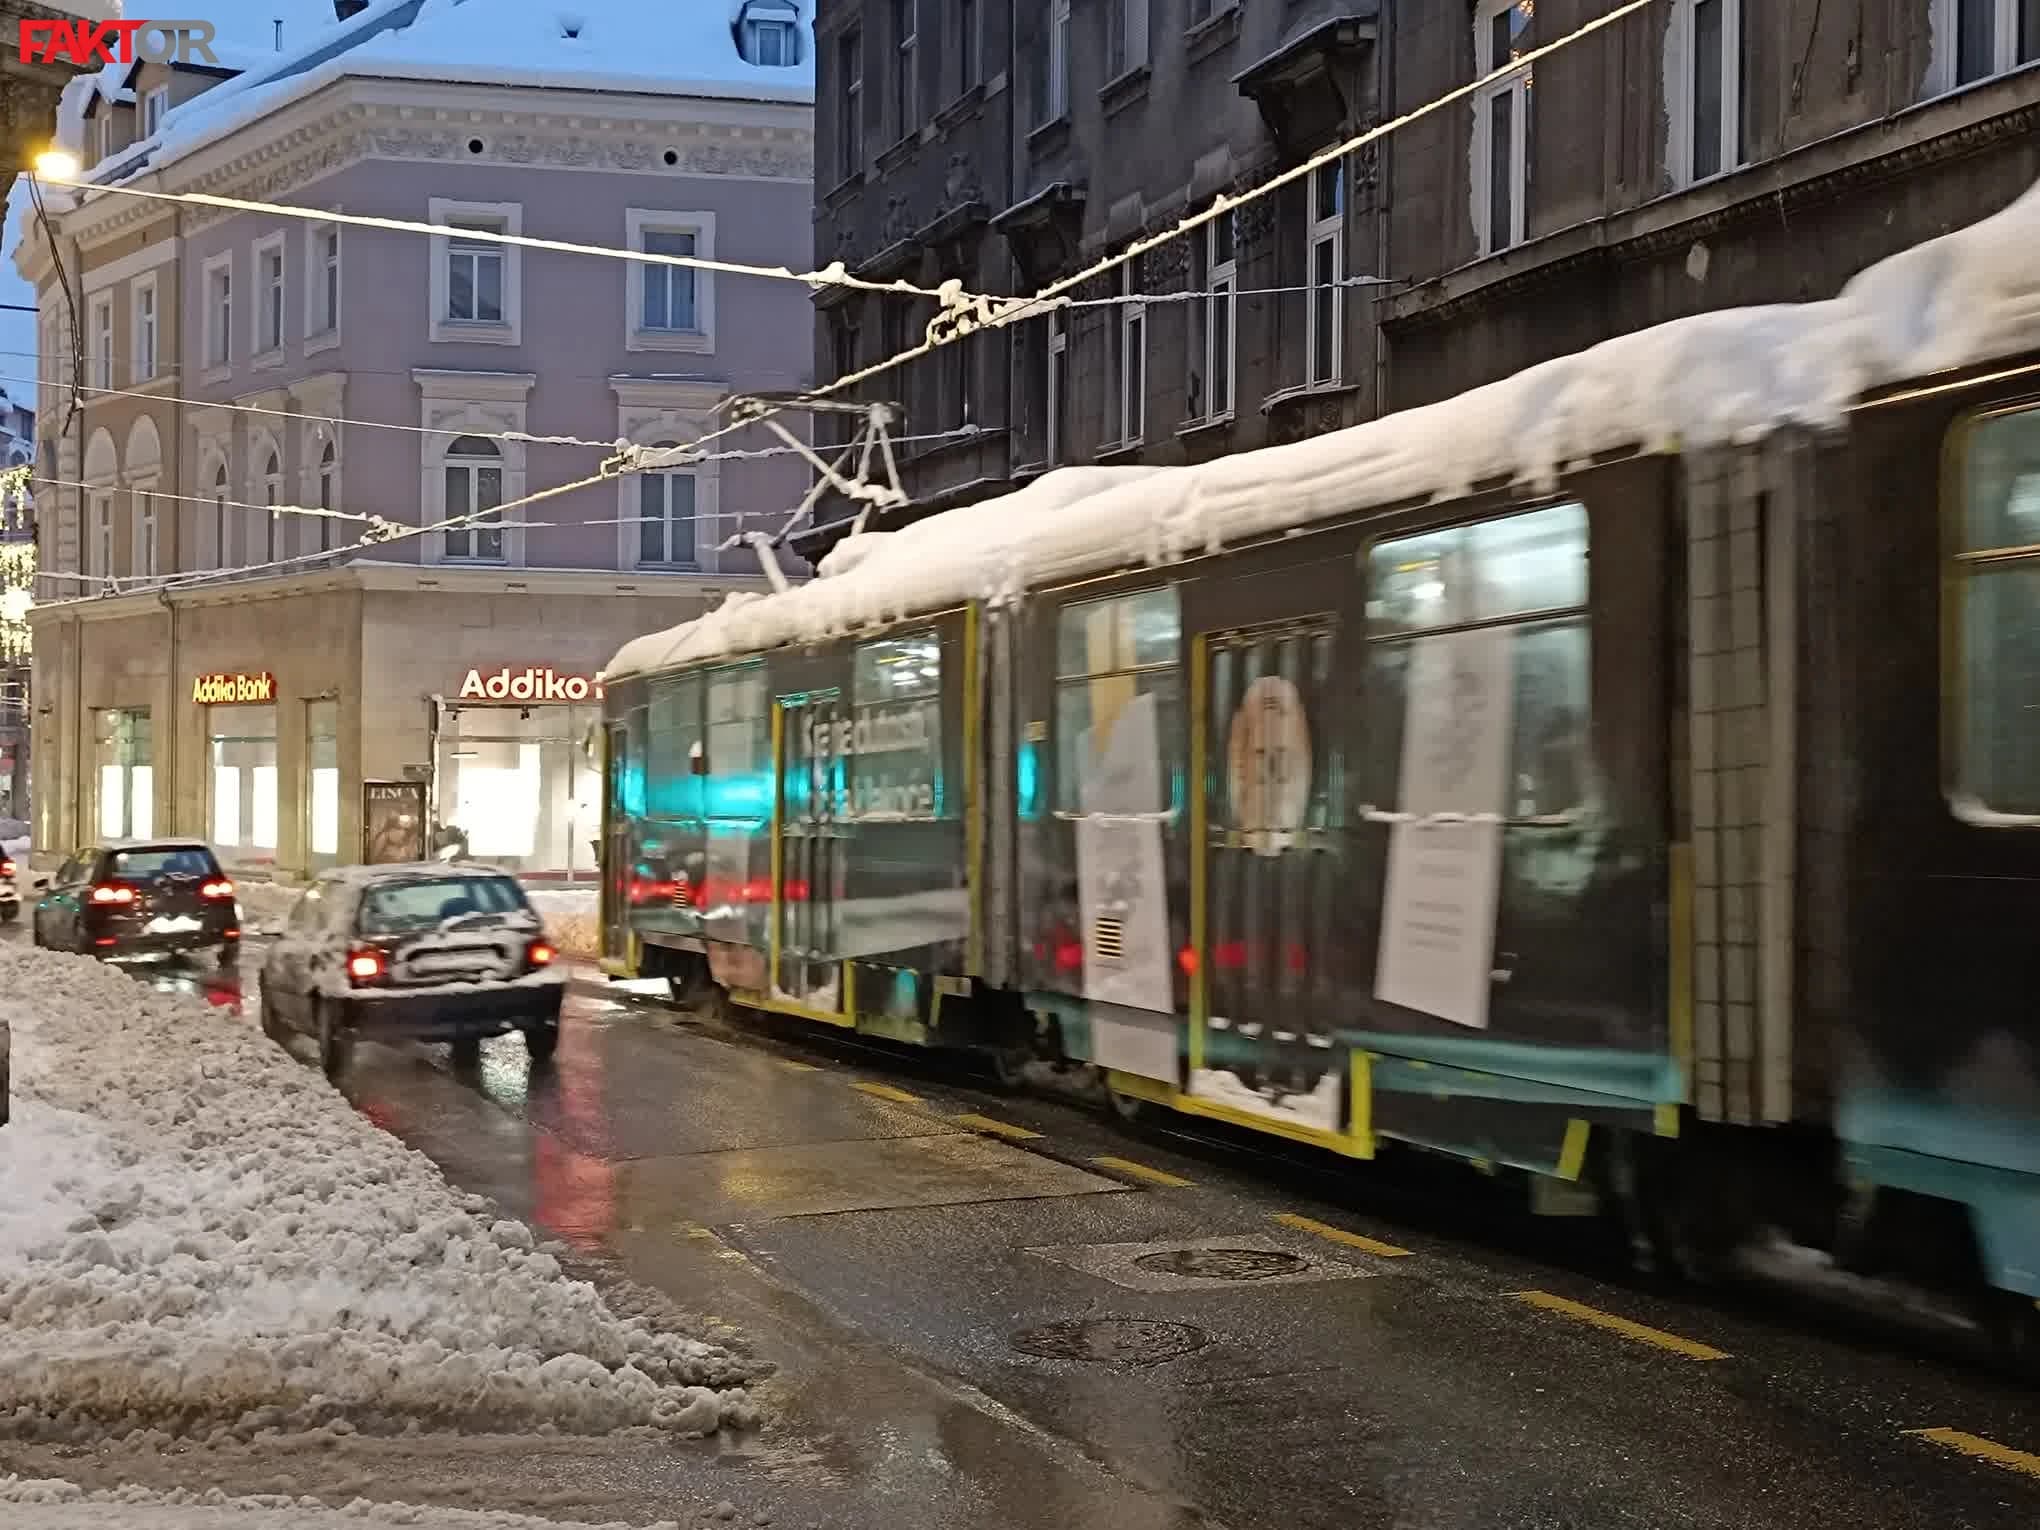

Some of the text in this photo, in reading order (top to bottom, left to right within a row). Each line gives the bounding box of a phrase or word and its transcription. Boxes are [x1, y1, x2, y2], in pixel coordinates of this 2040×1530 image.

[192, 671, 271, 702] Addiko Bank
[459, 668, 589, 699] Addiko
